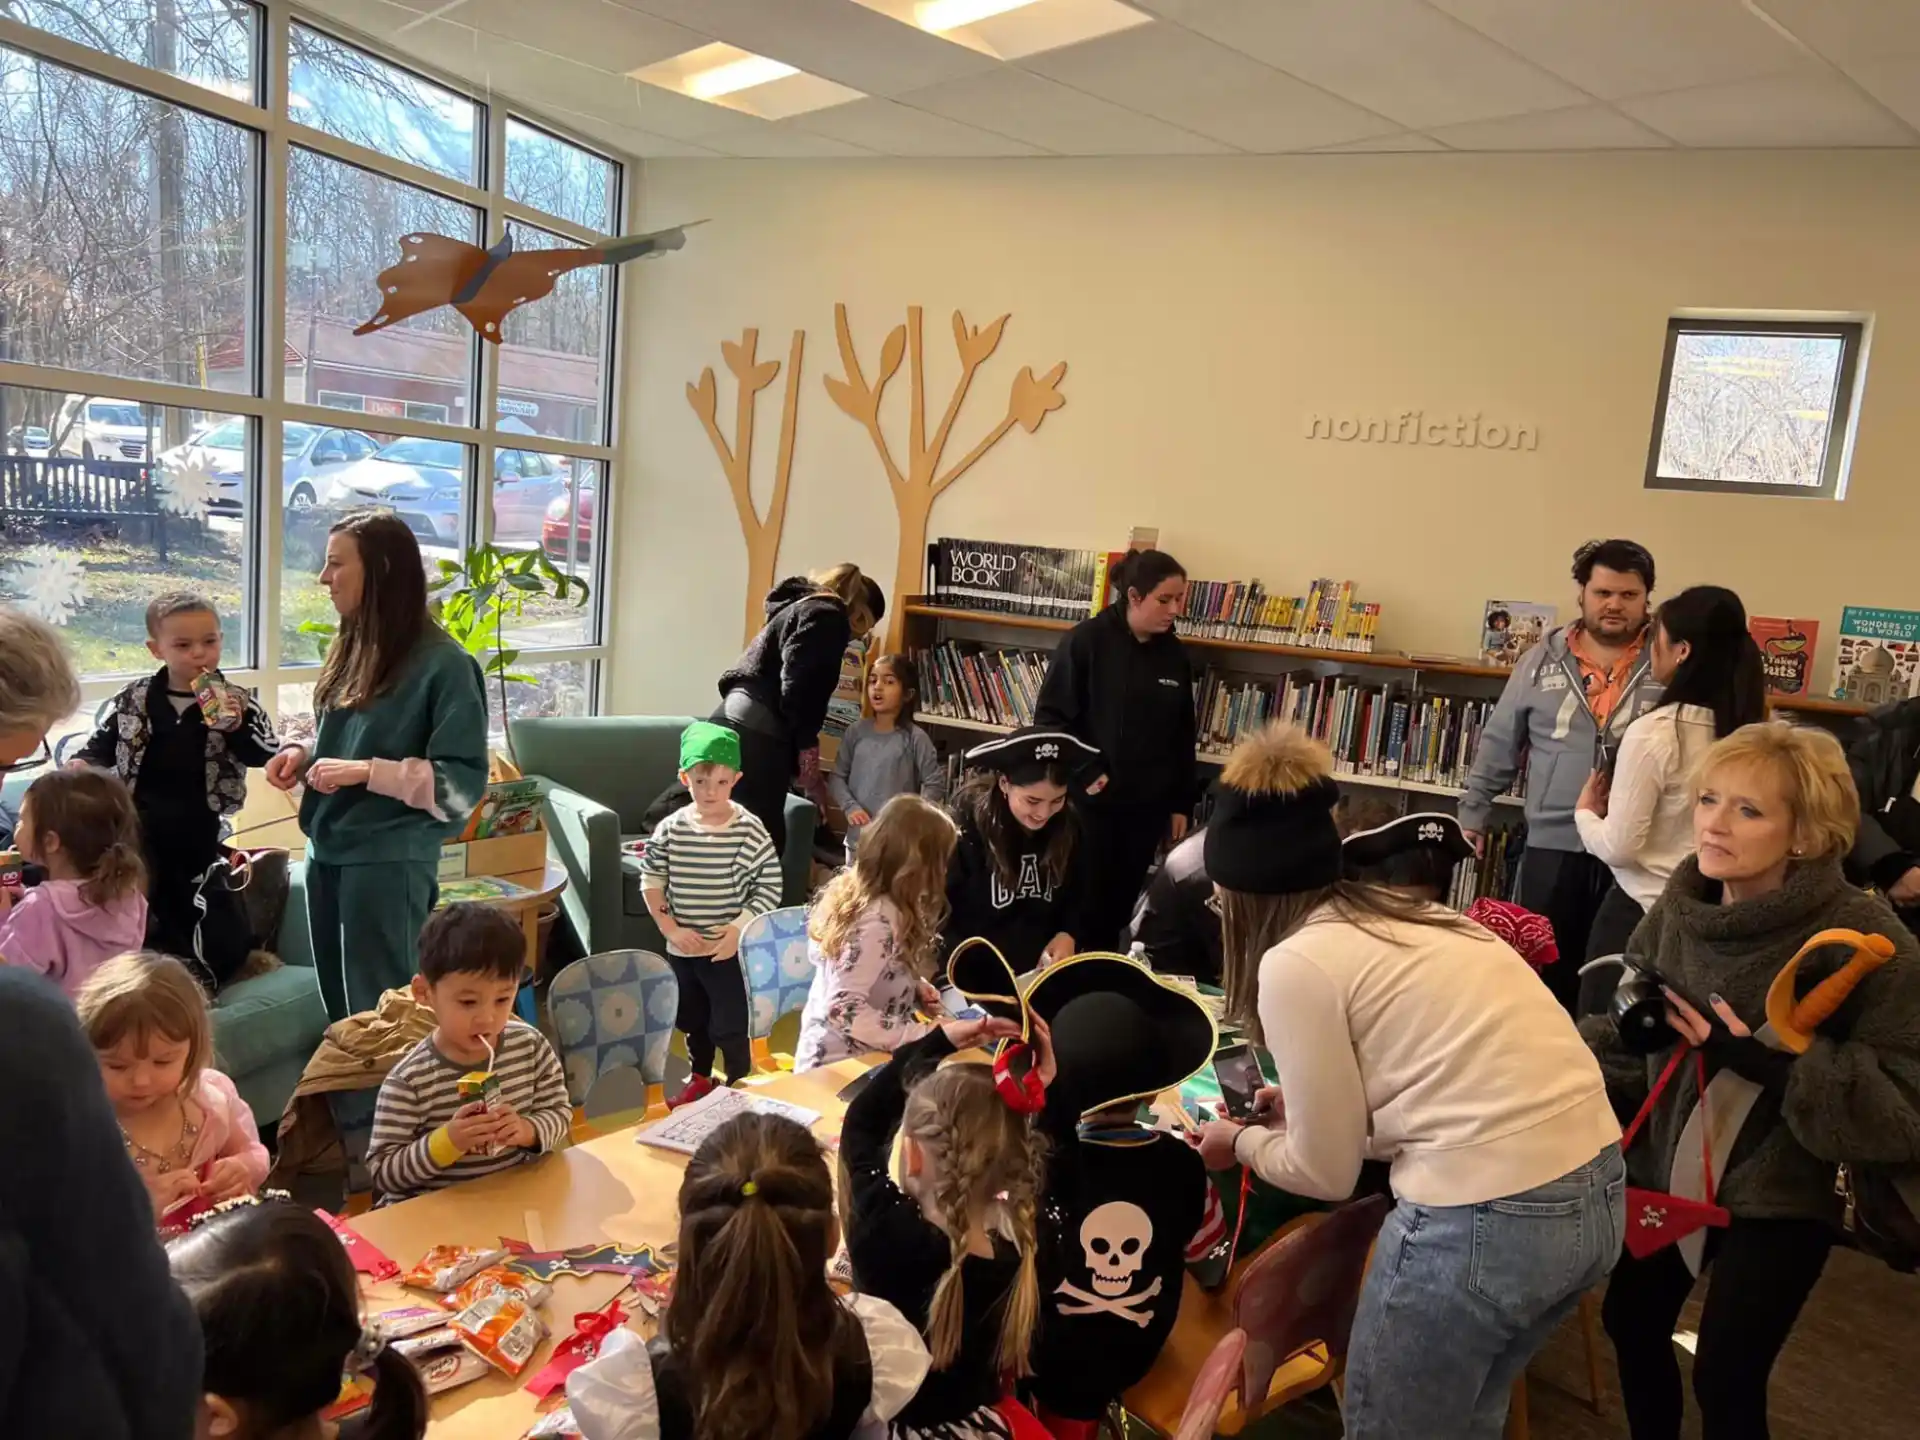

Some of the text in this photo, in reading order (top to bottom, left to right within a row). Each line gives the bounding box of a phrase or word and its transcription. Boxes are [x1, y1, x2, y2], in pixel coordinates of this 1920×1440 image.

[1304, 411, 1539, 451] nonfiction
[950, 550, 1016, 571] WORLD
[951, 566, 1000, 587] BOOK
[1852, 619, 1918, 632] WONDERS OF
[1856, 626, 1912, 637] THE WORLD
